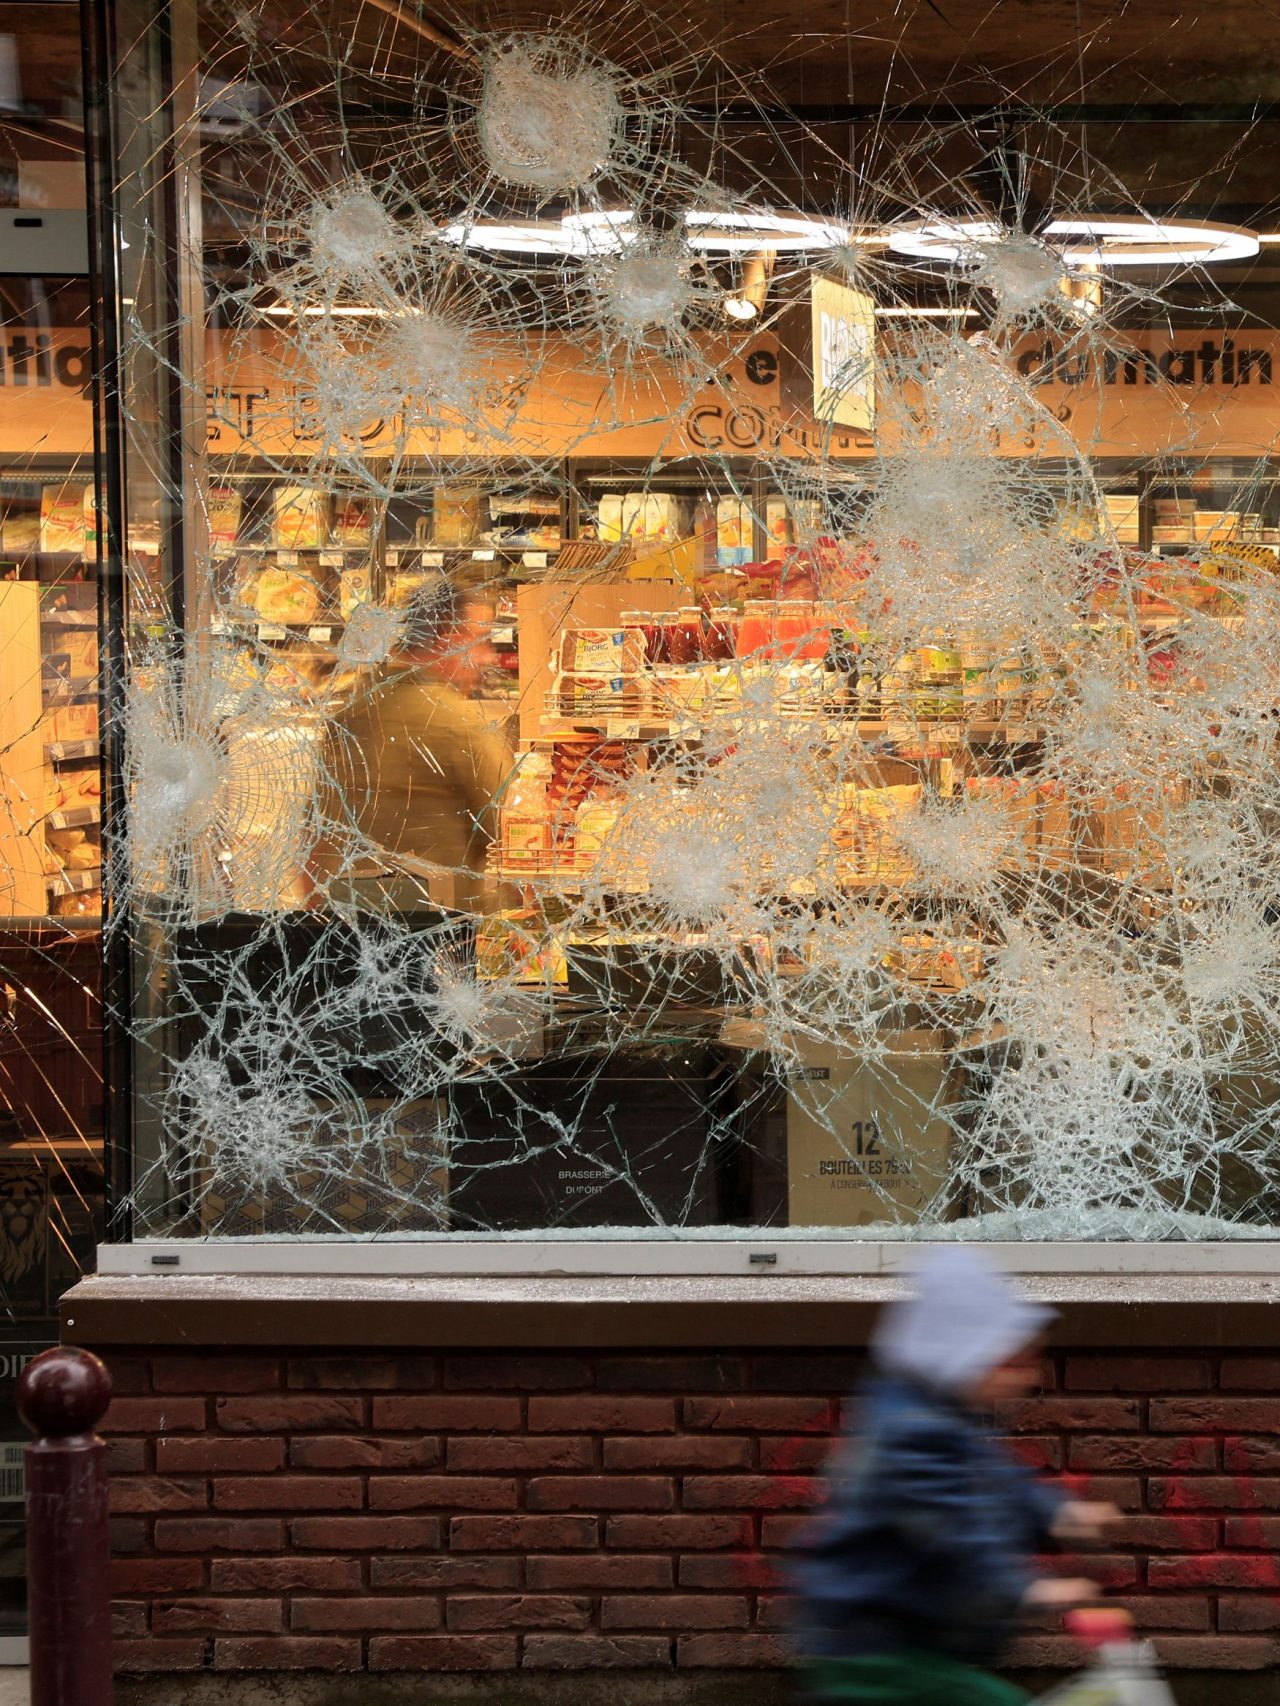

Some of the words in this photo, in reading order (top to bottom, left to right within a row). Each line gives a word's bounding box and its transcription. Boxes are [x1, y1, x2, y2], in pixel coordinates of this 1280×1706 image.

[1104, 341, 1272, 385] matin
[852, 1121, 881, 1155] 12
[558, 1170, 611, 1179] BRASSERIE
[820, 1160, 882, 1175] BOUTEILLES
[566, 1185, 602, 1194] DUPONT
